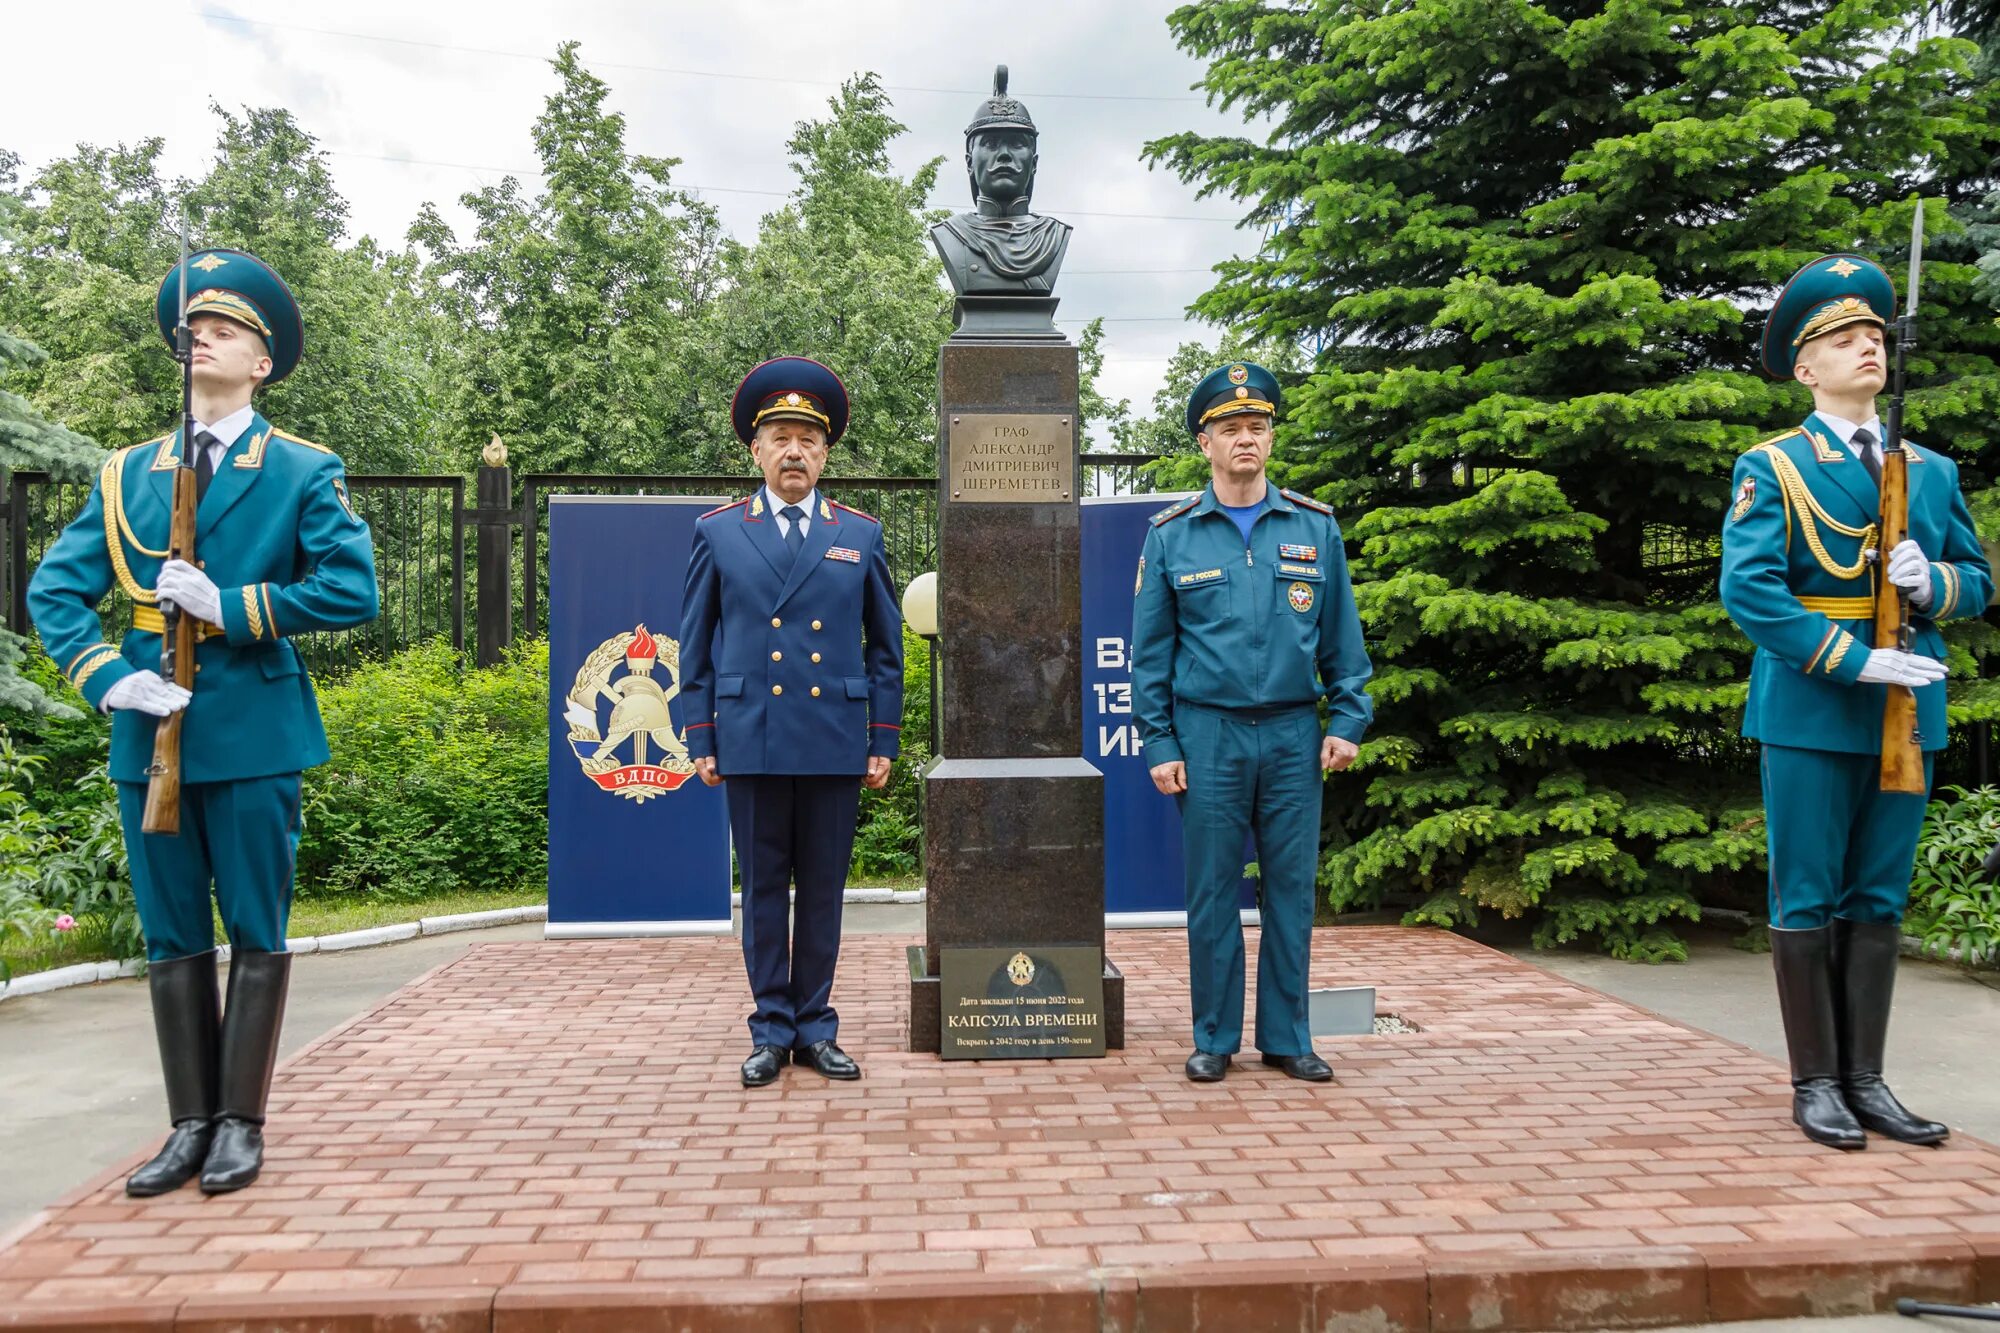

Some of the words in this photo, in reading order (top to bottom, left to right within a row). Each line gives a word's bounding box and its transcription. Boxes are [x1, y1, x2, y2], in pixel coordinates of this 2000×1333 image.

[995, 426, 1029, 437] ГРАФ
[969, 443, 1055, 456] АЛЕКСАНДР
[962, 461, 1060, 473] ДМИТРИЕВИЧ
[963, 478, 1061, 490] ШЕРЕМЕТЕВ
[1096, 637, 1133, 674] В
[613, 769, 669, 785] ВДПО
[959, 997, 978, 1007] Дата
[979, 998, 1014, 1006] закладки
[1015, 996, 1025, 1005] 15
[1026, 997, 1047, 1005] июня
[1048, 996, 1067, 1005] 2022
[1068, 996, 1085, 1005] года
[948, 1015, 1021, 1028] КАПСУЛА
[1025, 1013, 1098, 1027] ВРЕМЕНИ
[956, 1037, 988, 1047] Вскрыть
[995, 1036, 1013, 1045] 2042
[1014, 1037, 1031, 1047] году
[1038, 1037, 1055, 1045] день
[1056, 1035, 1092, 1045] 150-летия
